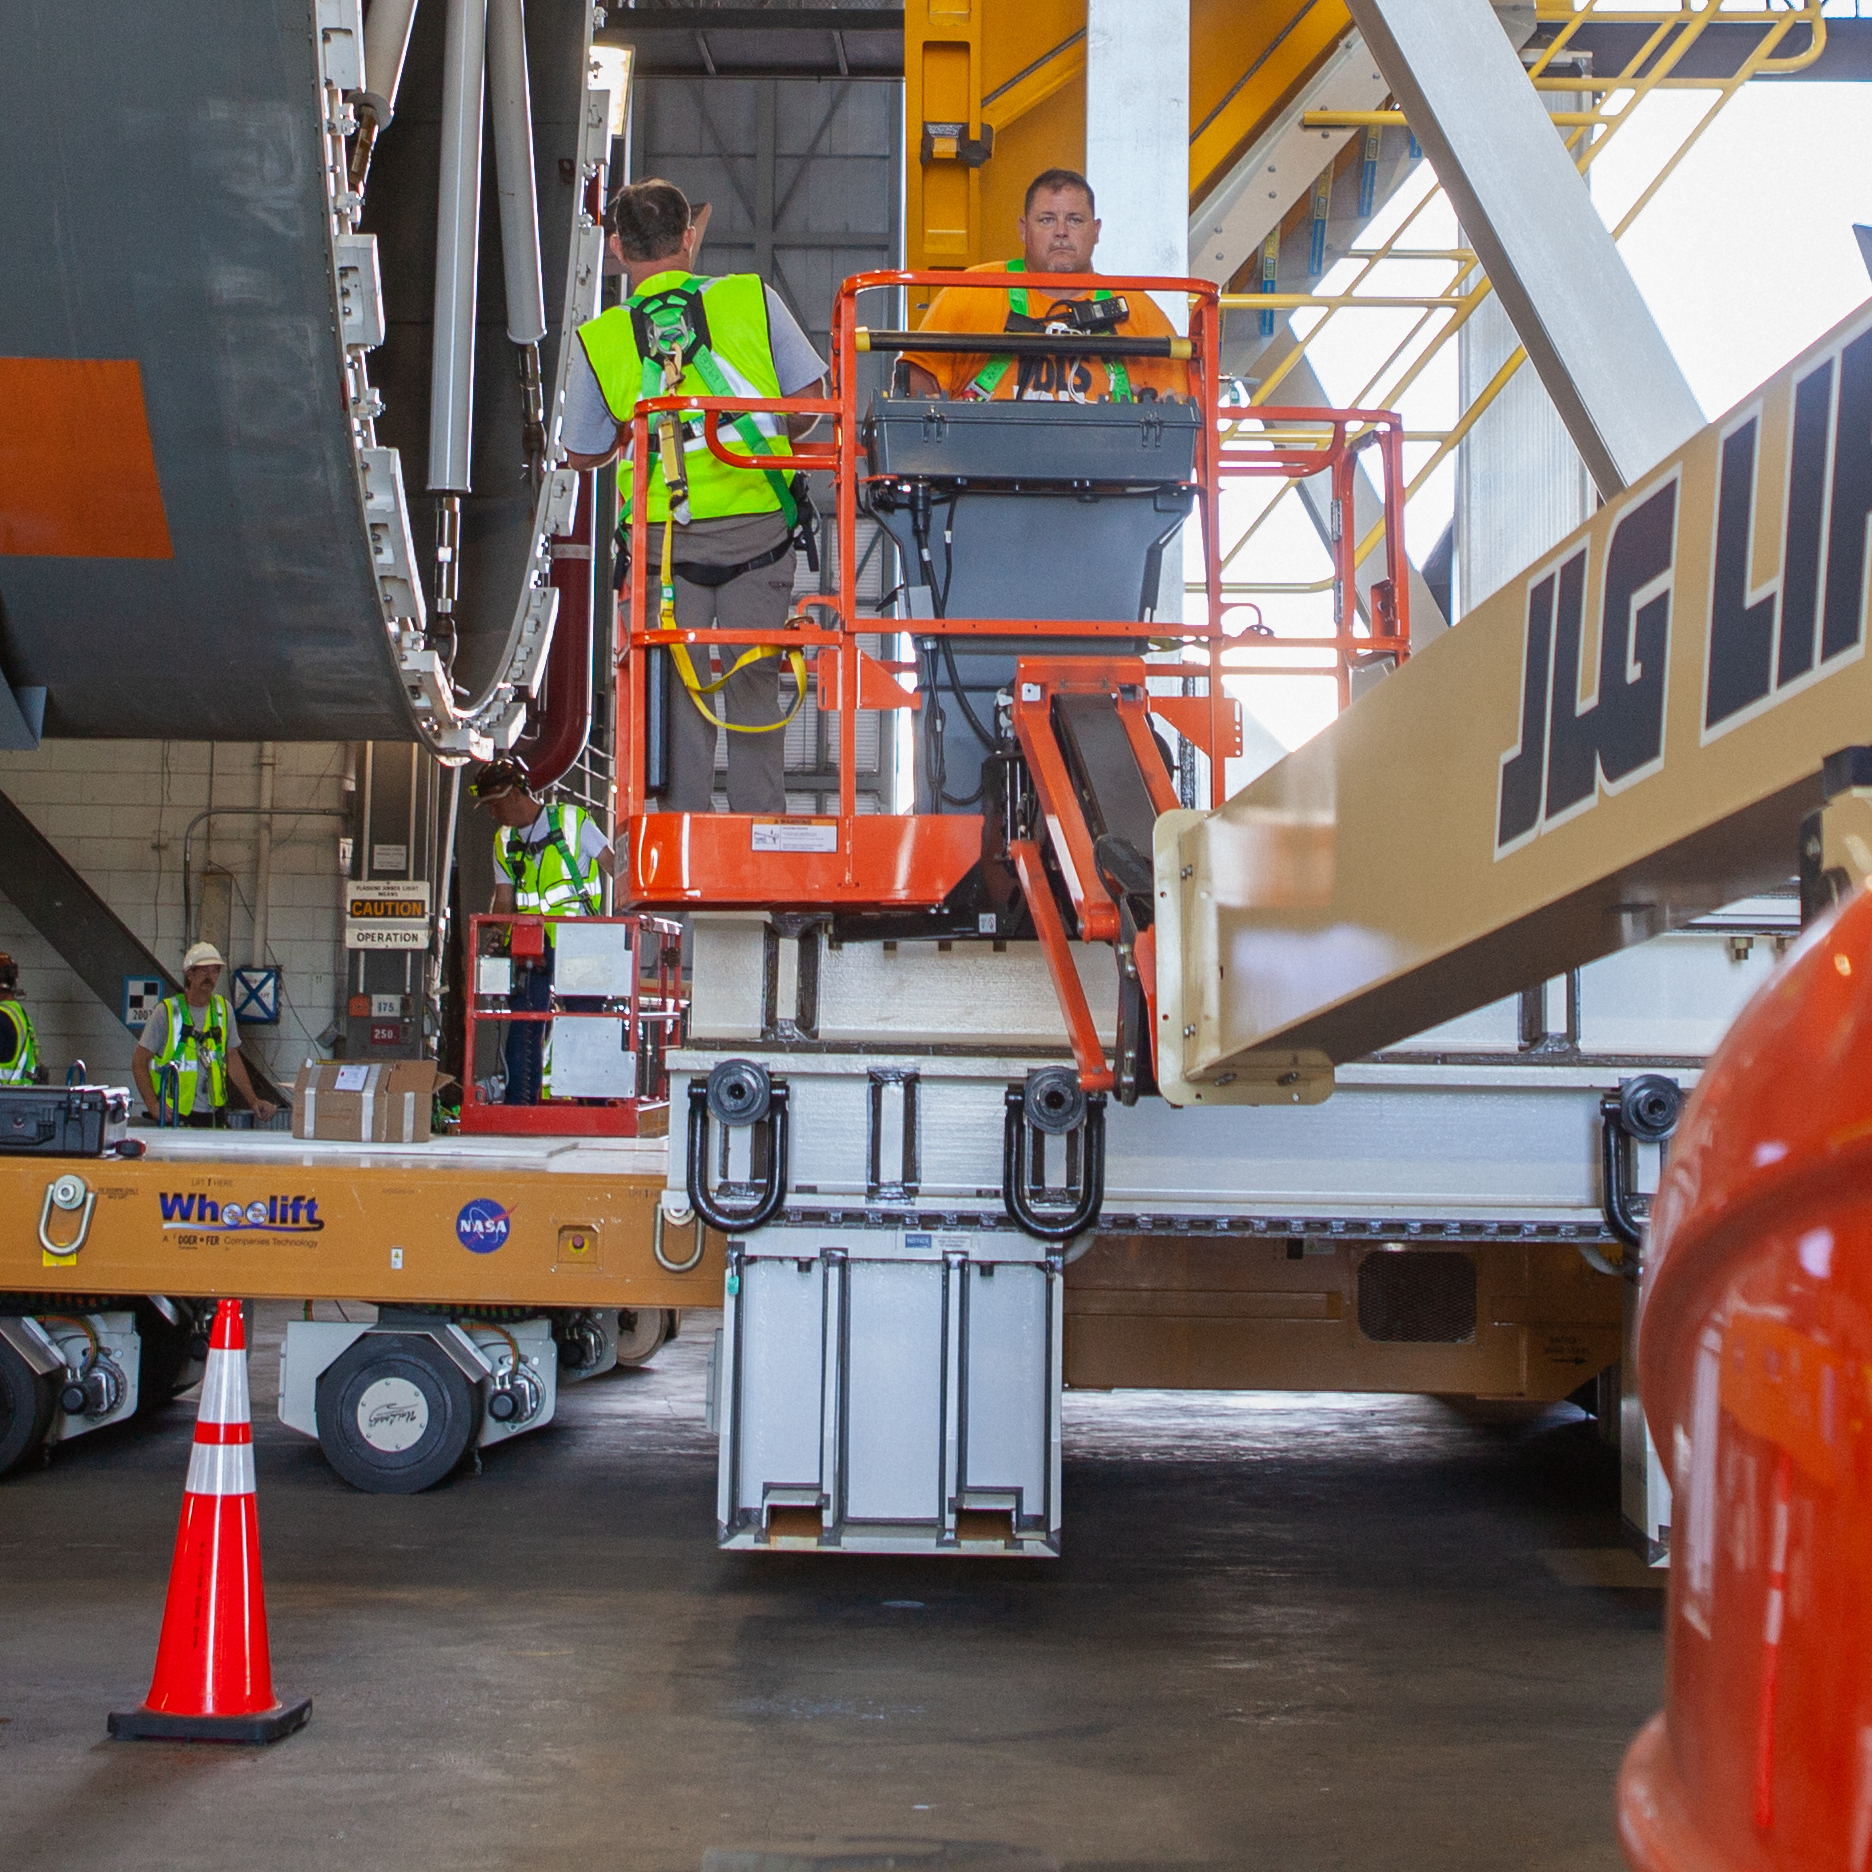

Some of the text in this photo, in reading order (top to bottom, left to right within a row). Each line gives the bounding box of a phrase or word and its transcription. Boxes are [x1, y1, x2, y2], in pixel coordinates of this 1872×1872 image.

[1494, 466, 1682, 858] JLG
[351, 901, 423, 917] CAUTION
[356, 932, 419, 943] OPERATION
[159, 1192, 321, 1227] Wheelift
[460, 1219, 508, 1233] NASA
[224, 1237, 270, 1247] Companies
[272, 1237, 319, 1249] Technology
